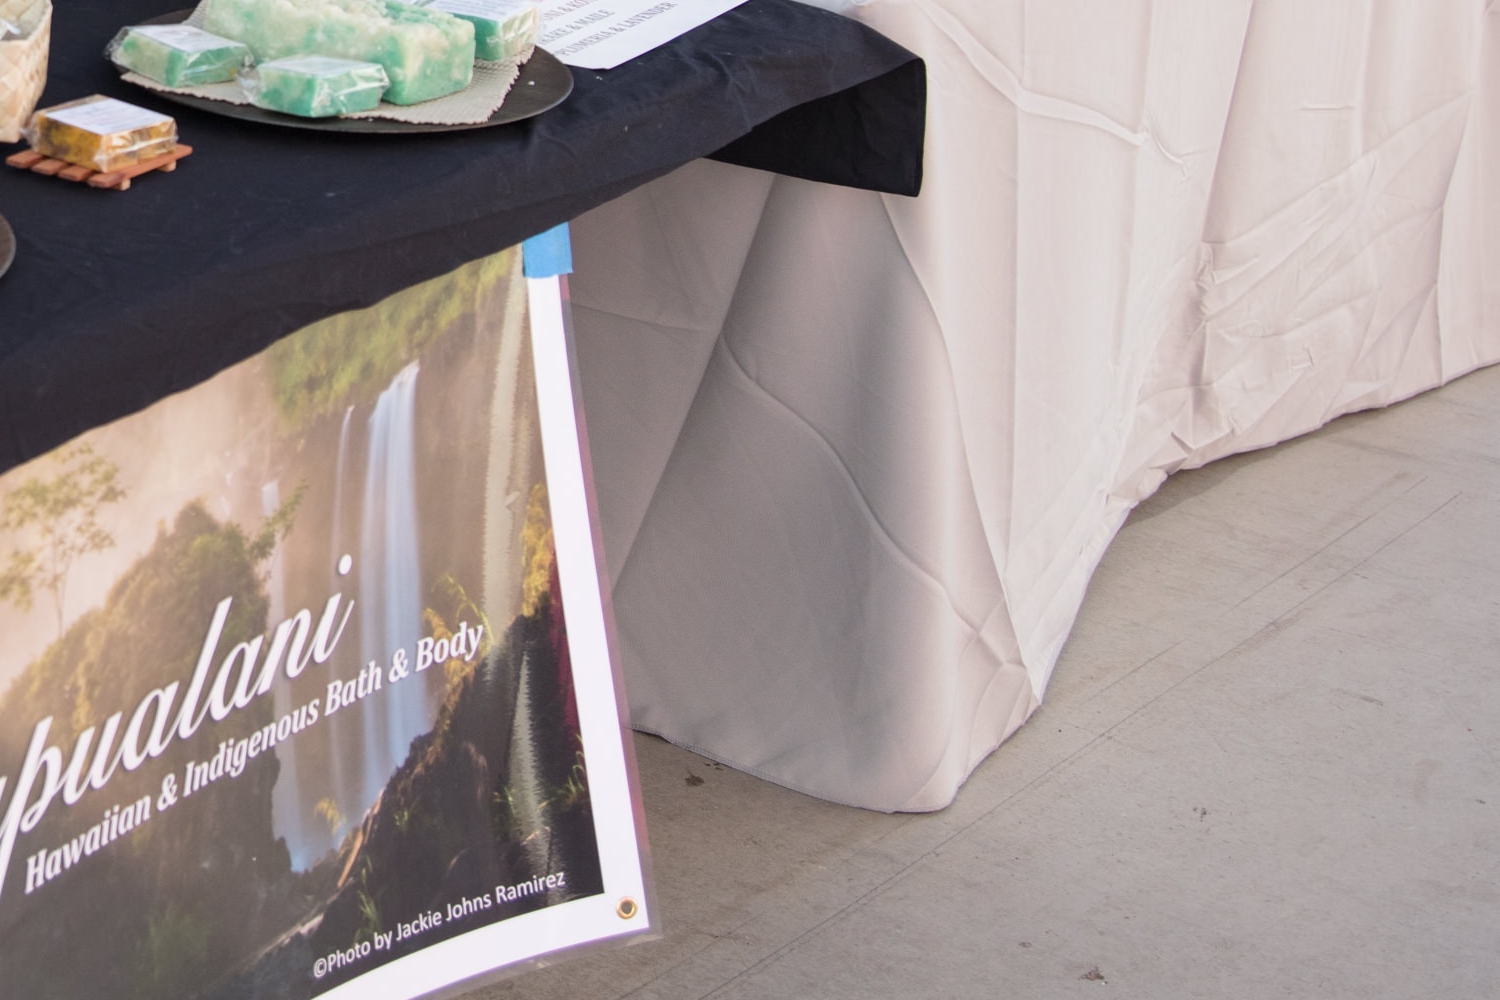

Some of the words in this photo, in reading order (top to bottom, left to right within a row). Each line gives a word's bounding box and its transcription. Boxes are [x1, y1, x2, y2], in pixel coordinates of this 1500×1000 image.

[617, 1, 679, 30] LAVENDER
[24, 794, 151, 895] Hawaiian
[156, 772, 179, 810] &
[183, 699, 320, 798] Indigenous
[325, 661, 382, 718] Bath
[388, 647, 410, 685] &
[415, 621, 485, 673] Body
[373, 929, 394, 951] by
[396, 909, 442, 942] Jackie
[445, 892, 492, 923] Johns
[496, 871, 567, 905] Ramirez
